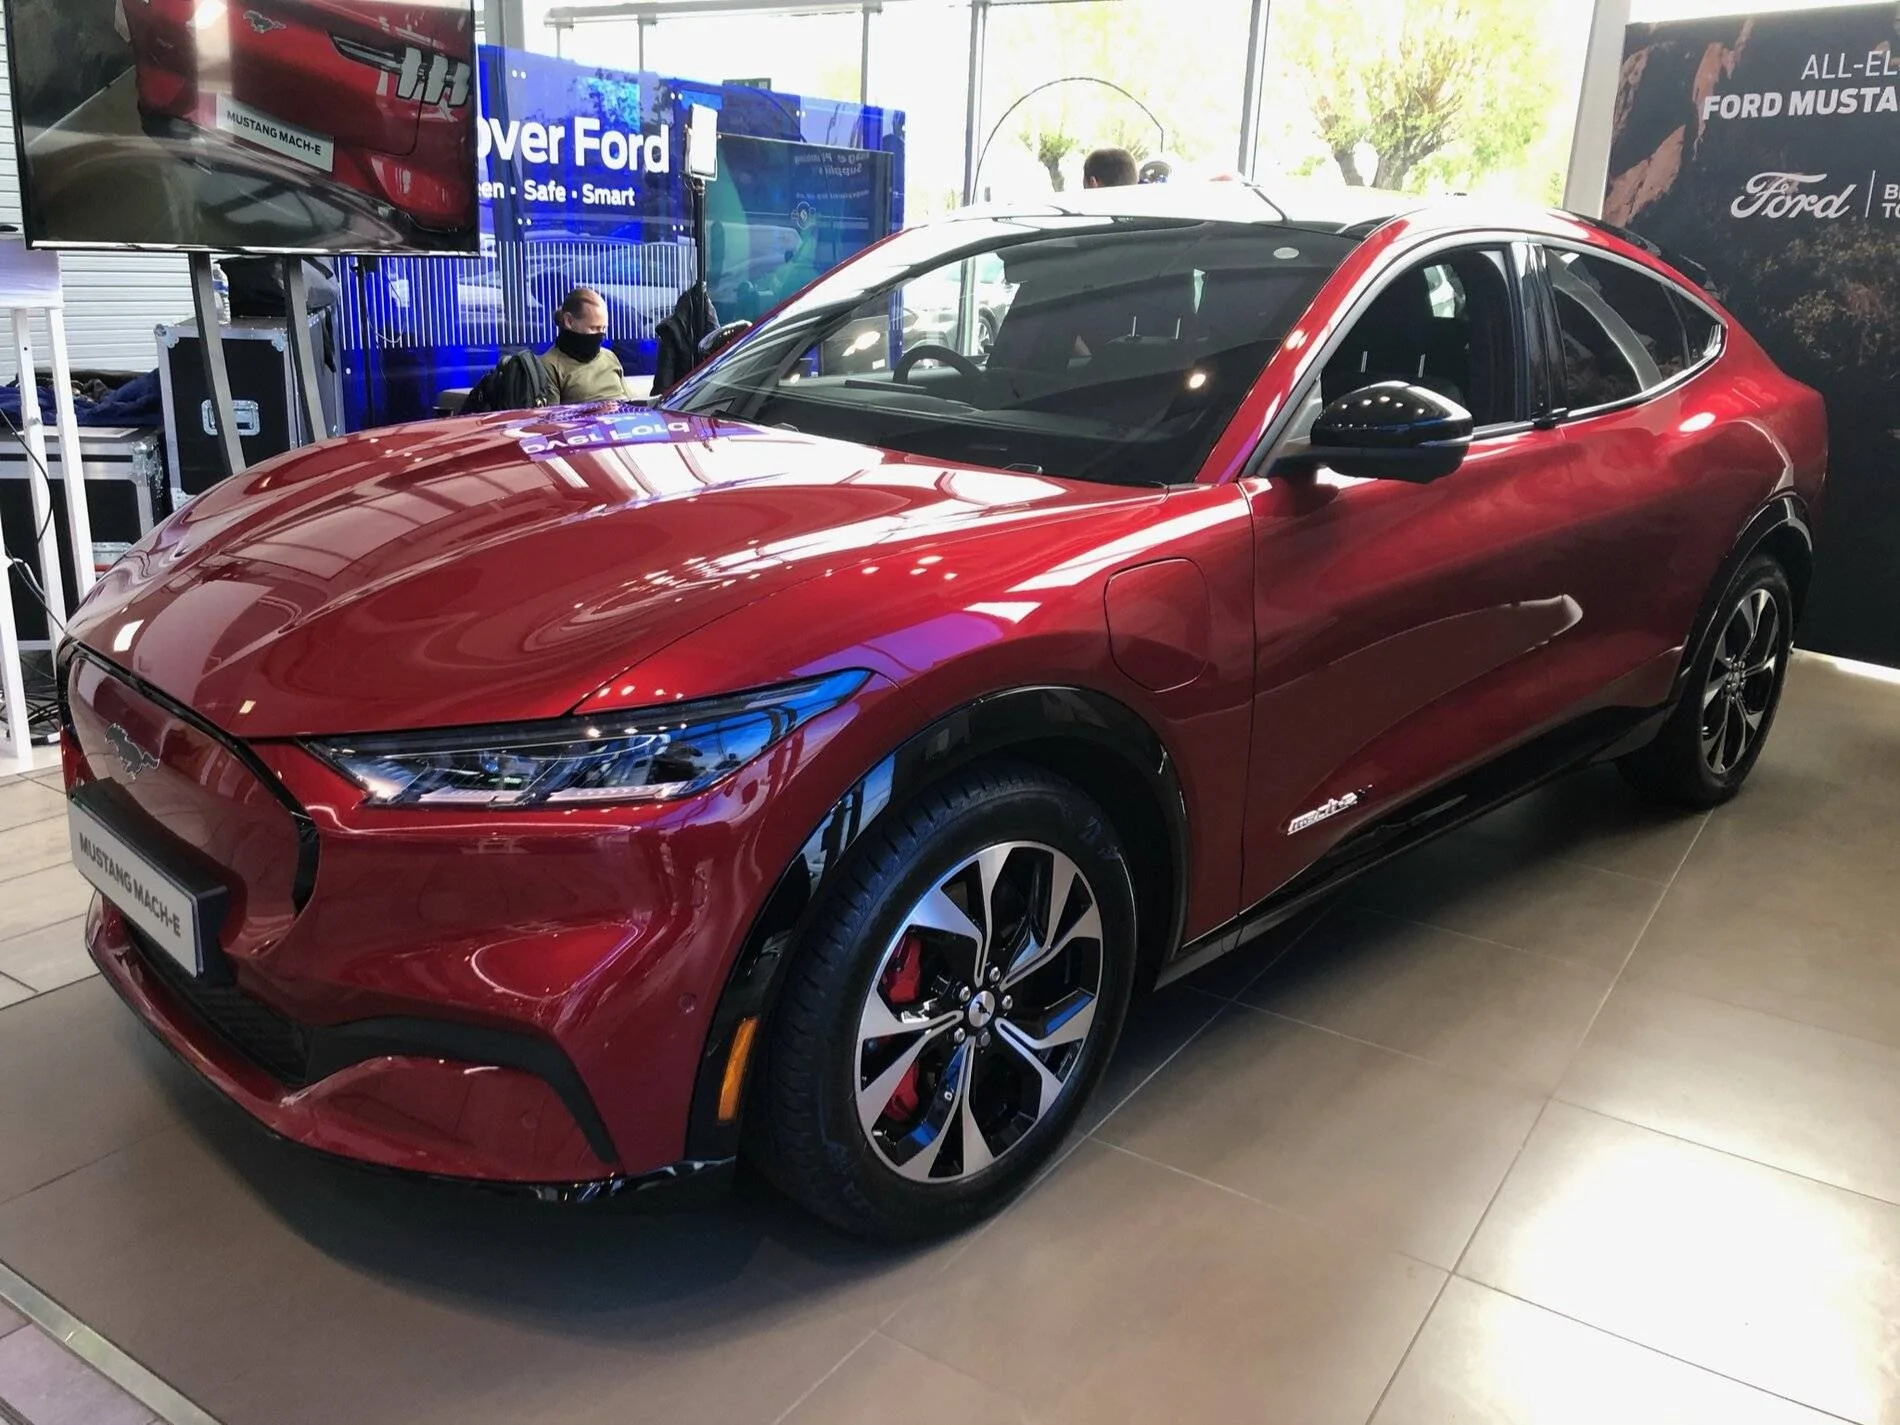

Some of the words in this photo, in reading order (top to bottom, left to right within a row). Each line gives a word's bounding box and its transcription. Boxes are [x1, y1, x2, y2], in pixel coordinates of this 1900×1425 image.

[1801, 50, 1900, 80] ALL-EL
[1703, 92, 1783, 120] FORD
[1788, 86, 1898, 117] MUSTA
[226, 110, 278, 138] MUSTANG
[279, 131, 322, 156] MACH-E
[574, 116, 670, 174] Ford
[478, 180, 505, 199] en
[523, 179, 567, 203] Safe
[582, 183, 636, 206] Smart
[1731, 171, 1858, 219] Ford
[79, 832, 133, 893] MUSTANG
[133, 878, 182, 938] MACH-E
